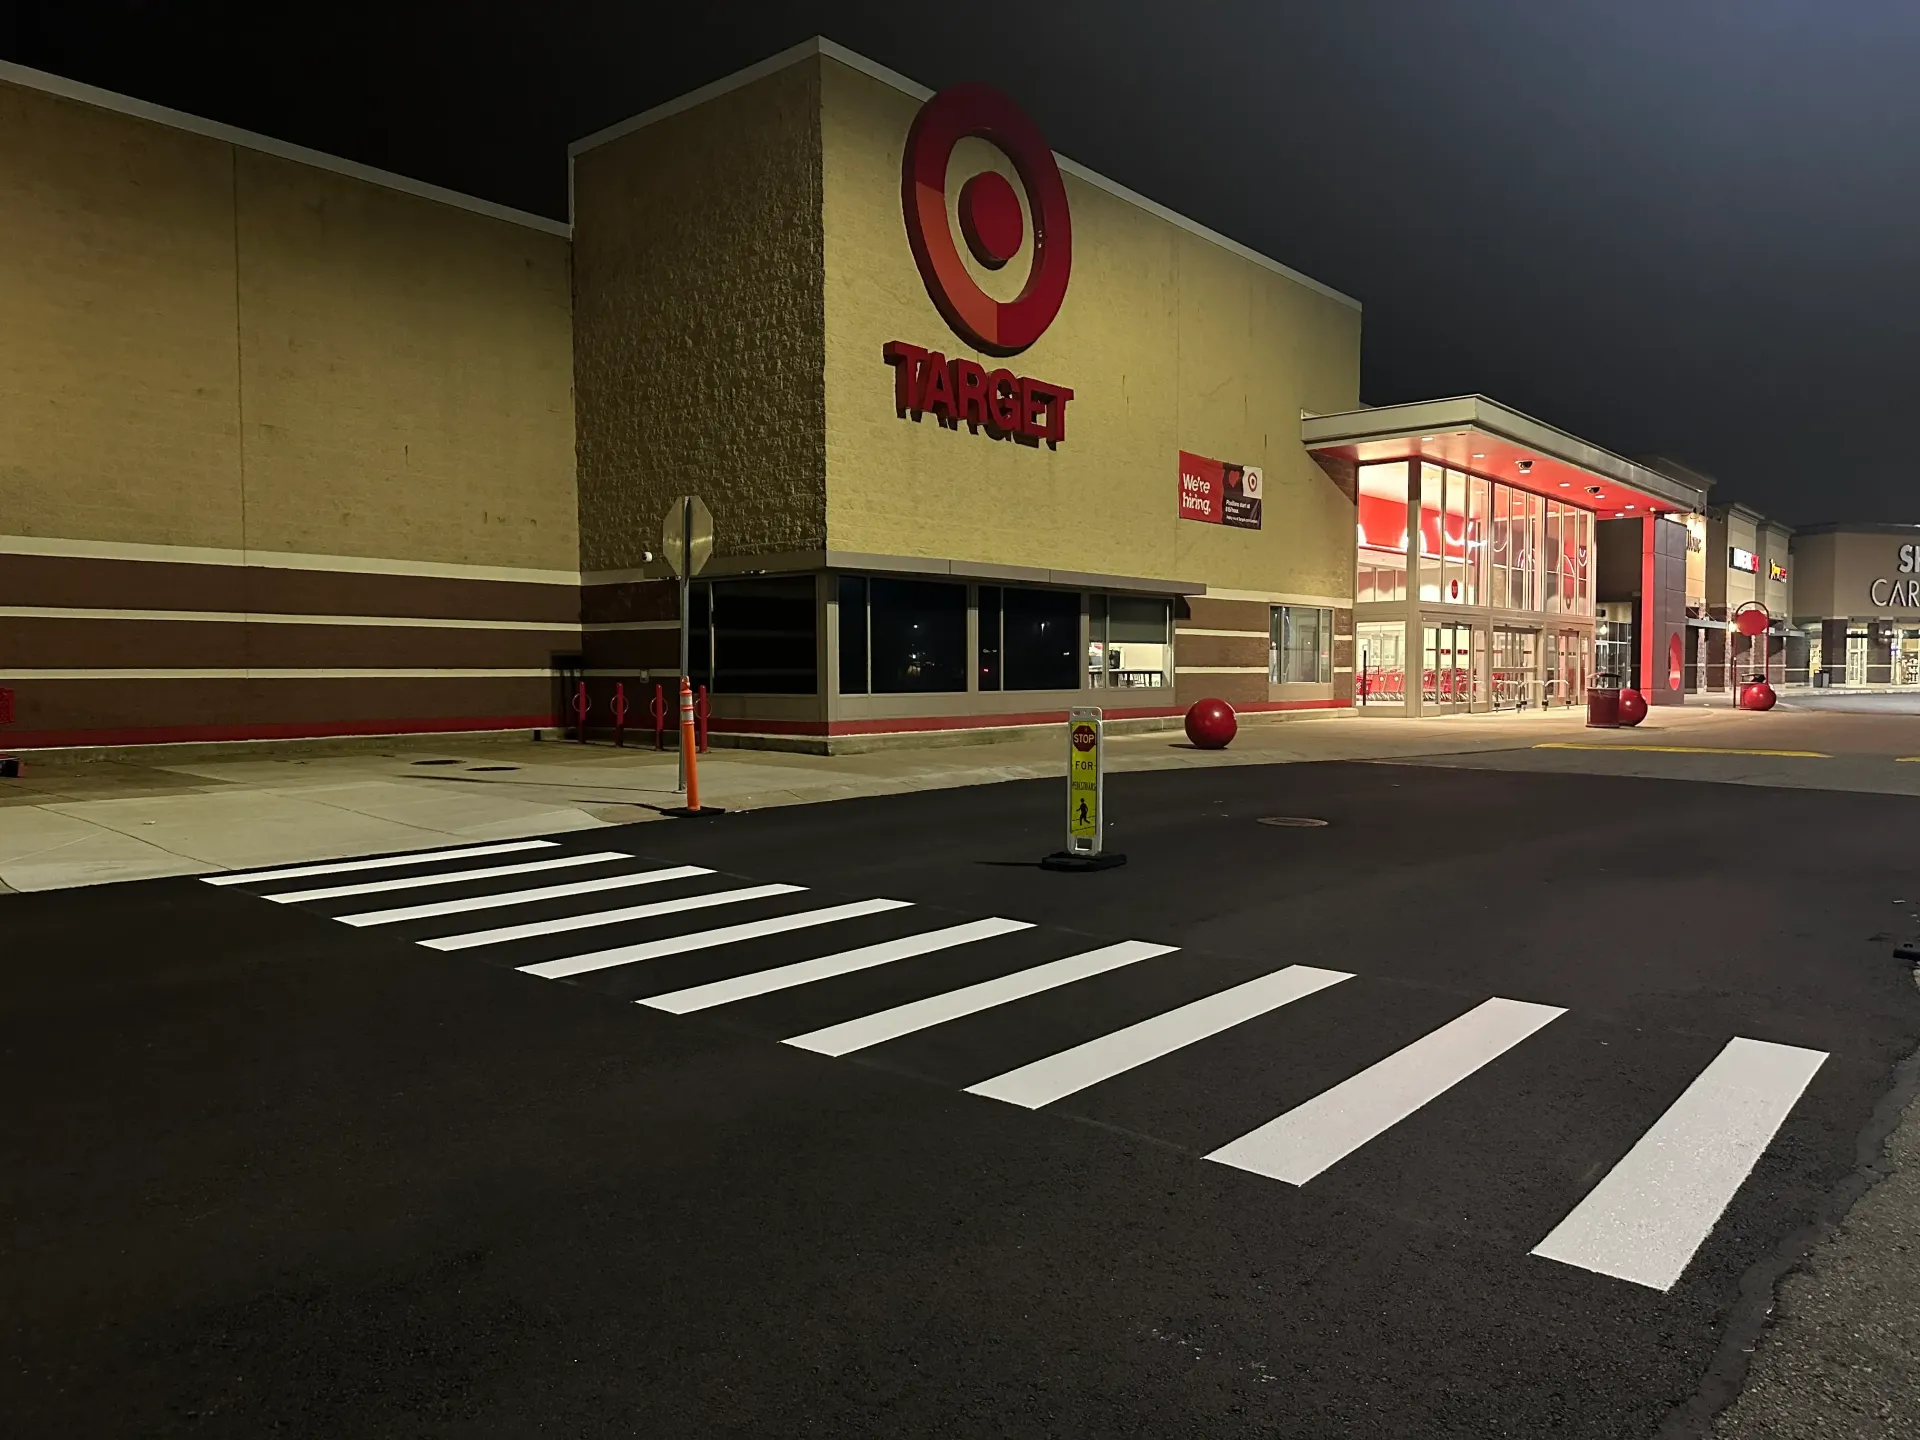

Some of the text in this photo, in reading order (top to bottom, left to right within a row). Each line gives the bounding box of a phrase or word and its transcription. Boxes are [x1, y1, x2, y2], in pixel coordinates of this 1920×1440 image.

[883, 340, 1074, 446] TARGET
[1182, 472, 1211, 494] We're
[1182, 491, 1211, 516] hiring.
[1073, 733, 1095, 744] STOP
[1075, 760, 1093, 770] FOR
